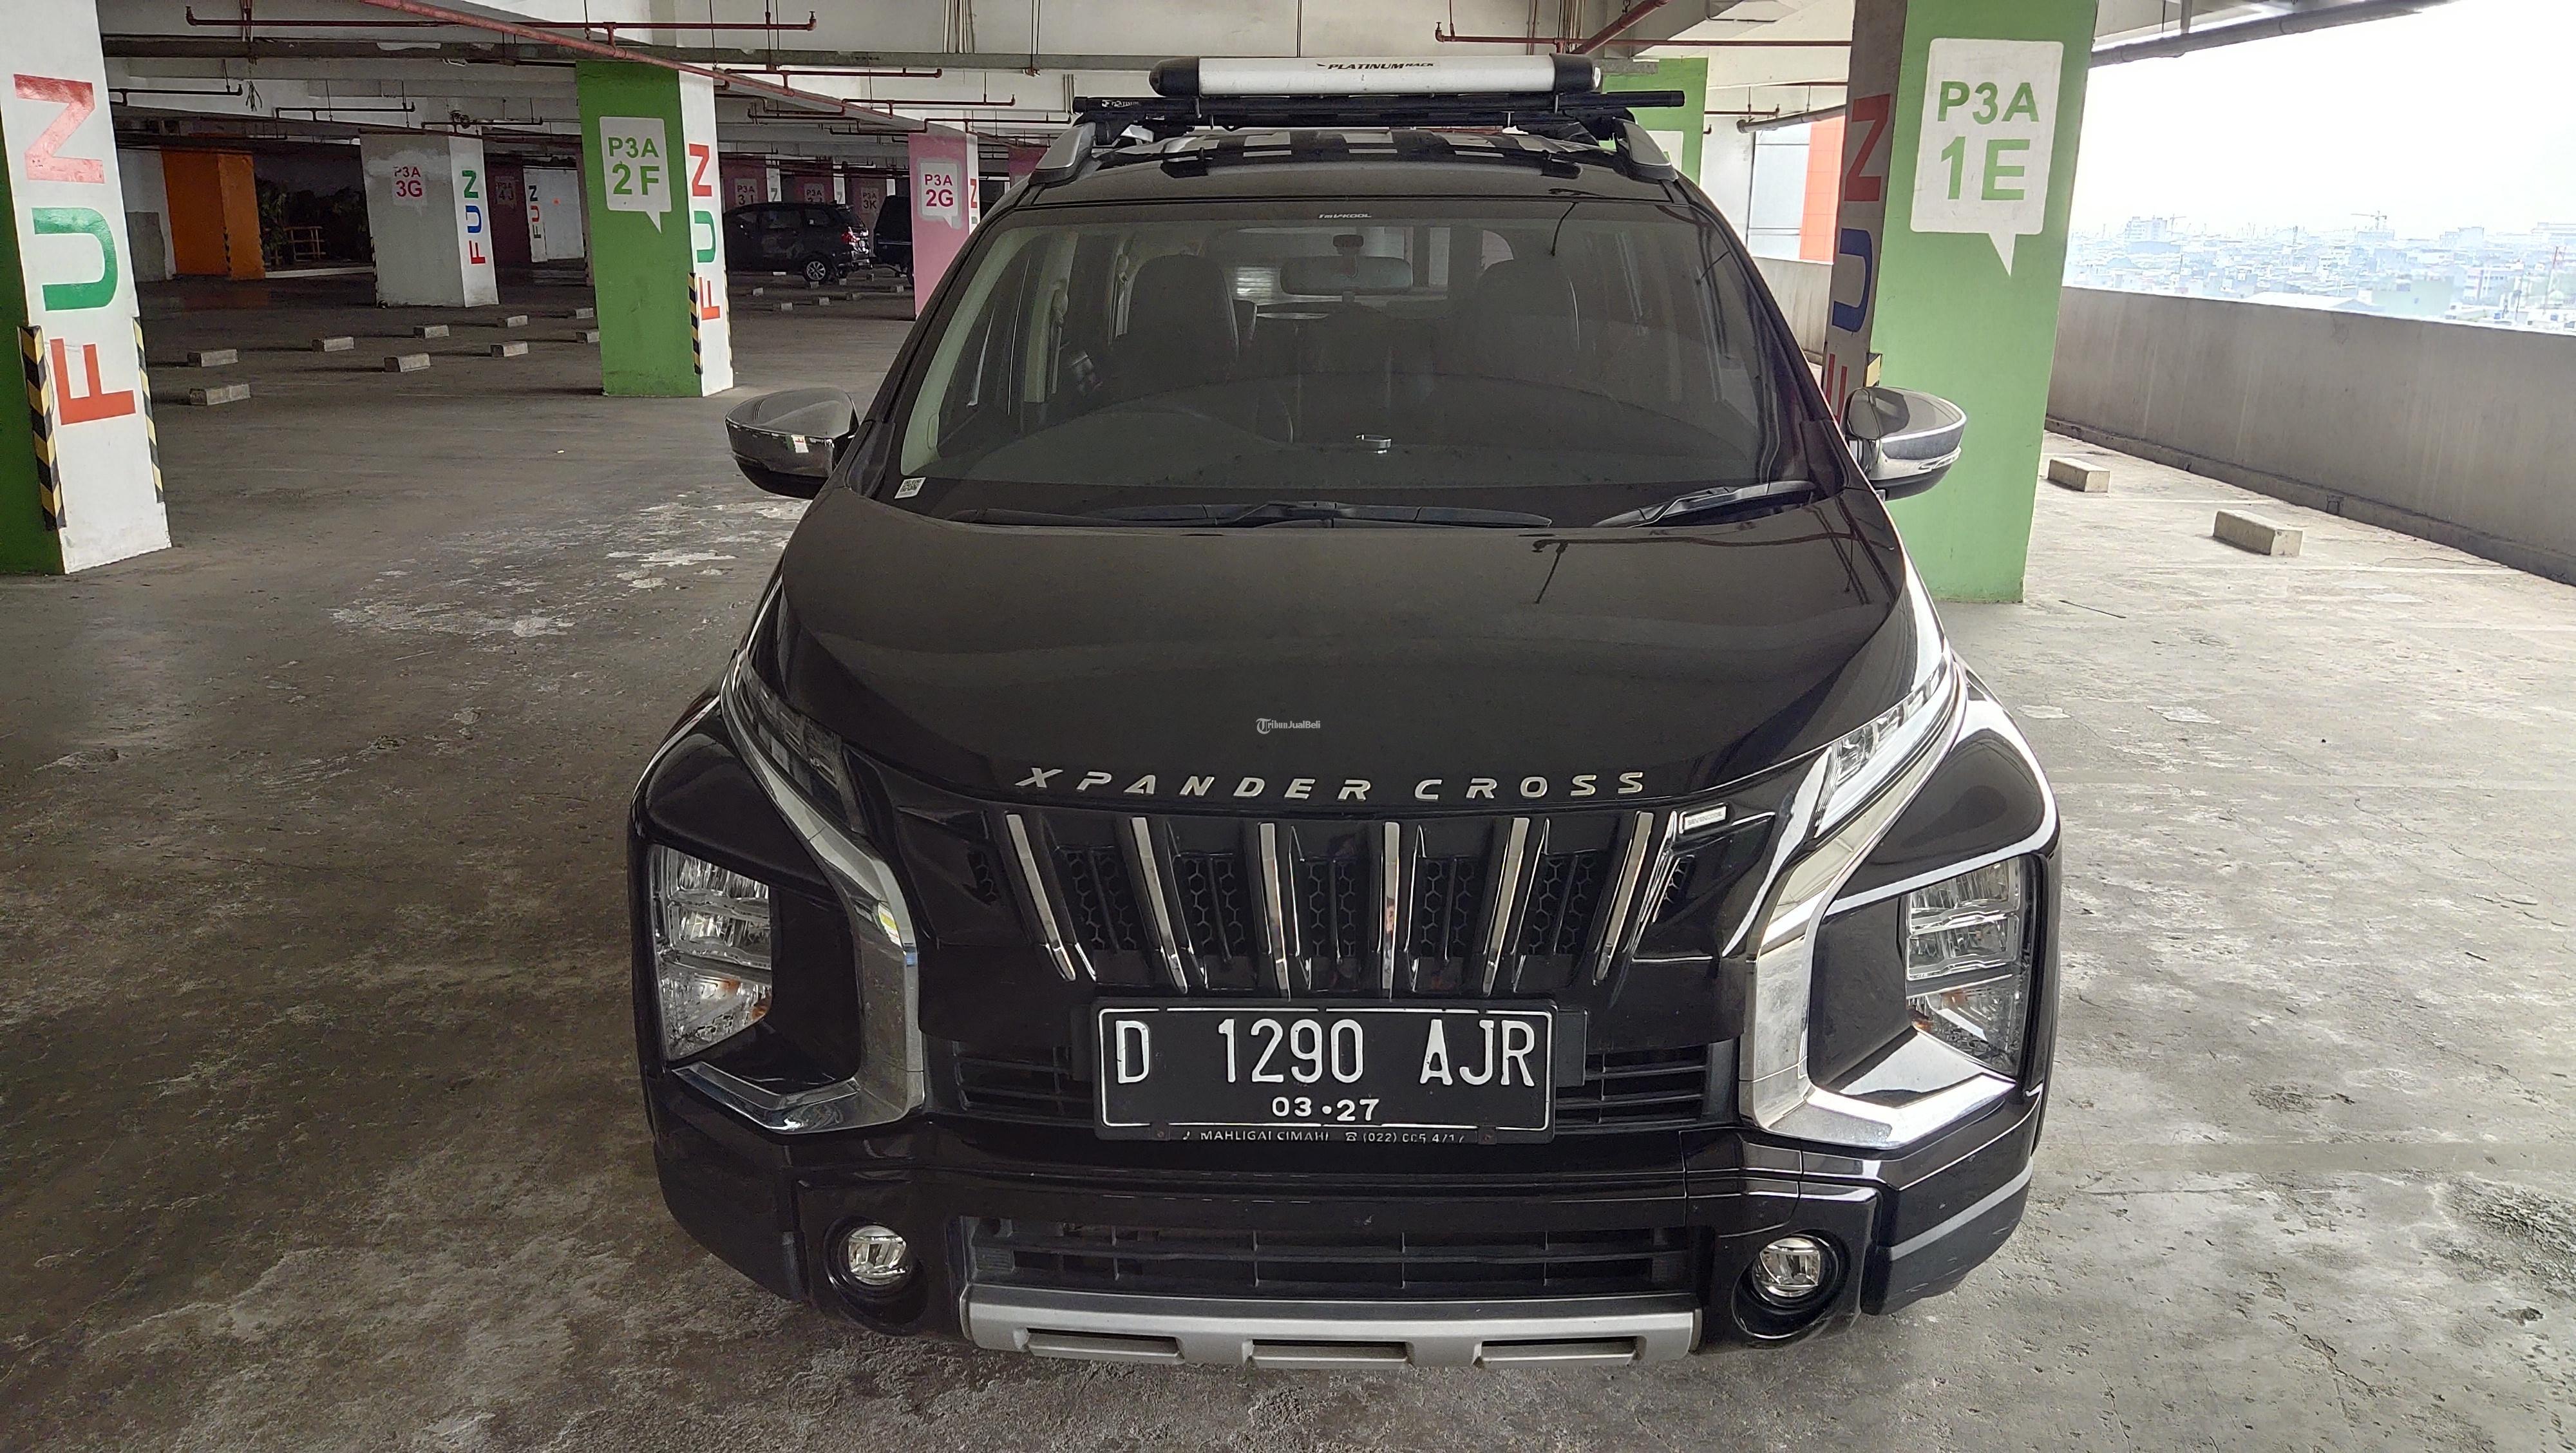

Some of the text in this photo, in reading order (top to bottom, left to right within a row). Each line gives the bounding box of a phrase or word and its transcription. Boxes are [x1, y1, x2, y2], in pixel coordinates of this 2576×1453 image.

[1937, 81, 2040, 125] P3A
[608, 137, 659, 158] P3A
[612, 163, 660, 196] 2F
[924, 174, 952, 186] P3A
[1940, 136, 2031, 201] 1E
[395, 180, 423, 198] 3G
[737, 185, 755, 193] P3A
[863, 200, 877, 209] 3K
[925, 189, 954, 207] 2G
[462, 170, 486, 265] FUN
[528, 185, 542, 239] FUN
[688, 142, 721, 321] FUN
[14, 74, 136, 425] FUN
[1014, 766, 1643, 801] XPANDER CROSS
[1116, 1018, 1535, 1087] D 1290 AJR
[1200, 1130, 1272, 1141] MAHLIGAI
[1276, 1131, 1329, 1141] CIMAHI
[1363, 1132, 1397, 1143] (022)
